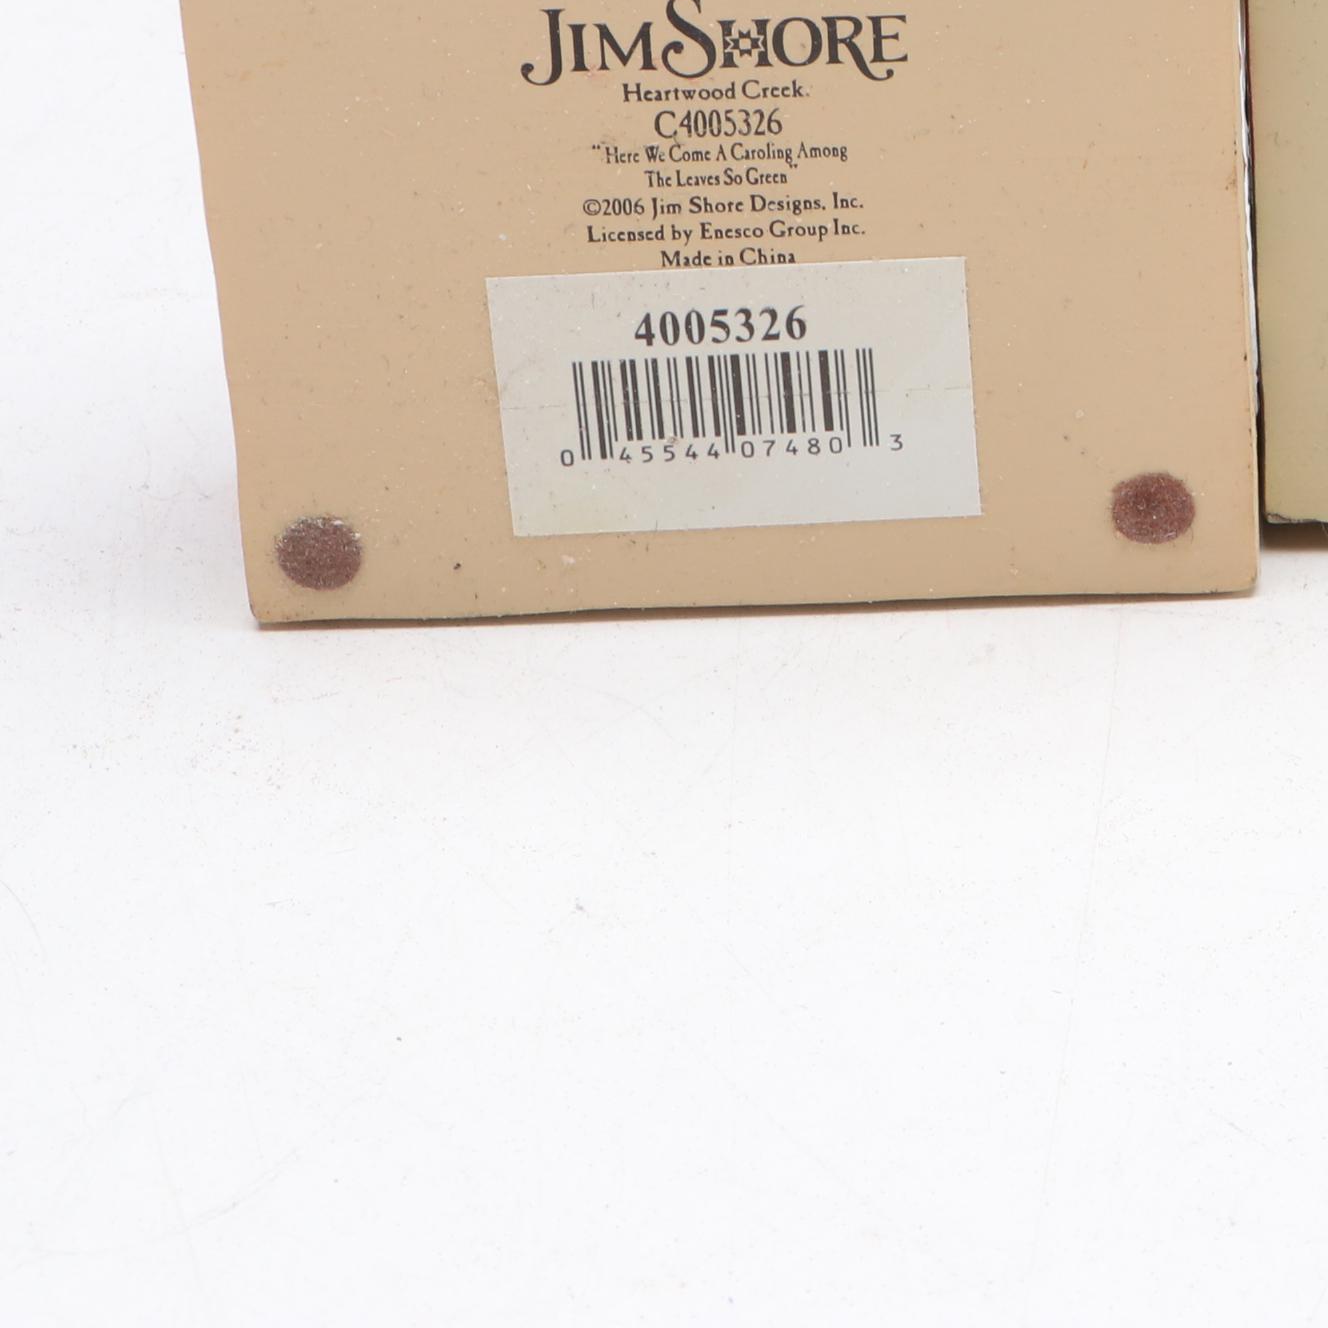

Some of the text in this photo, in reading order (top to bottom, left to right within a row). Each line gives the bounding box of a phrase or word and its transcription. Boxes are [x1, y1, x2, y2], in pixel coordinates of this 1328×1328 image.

[623, 79, 810, 102] Heartwood Creek.
[654, 108, 783, 139] C4005326
[644, 144, 666, 163] We
[669, 143, 711, 162] Come
[716, 143, 728, 161] A
[730, 142, 793, 164] Caroling
[797, 141, 848, 162] Among
[644, 170, 672, 188] The
[676, 169, 720, 187] Leaves
[723, 168, 743, 186] So
[583, 197, 645, 216] ©2006
[651, 196, 682, 221] Jim
[689, 195, 745, 214] Shore
[832, 192, 864, 210] Inc.
[587, 218, 865, 245] Licensed by Enesco Group Inc.
[661, 246, 796, 267] Made in China
[634, 305, 807, 347] 4005326
